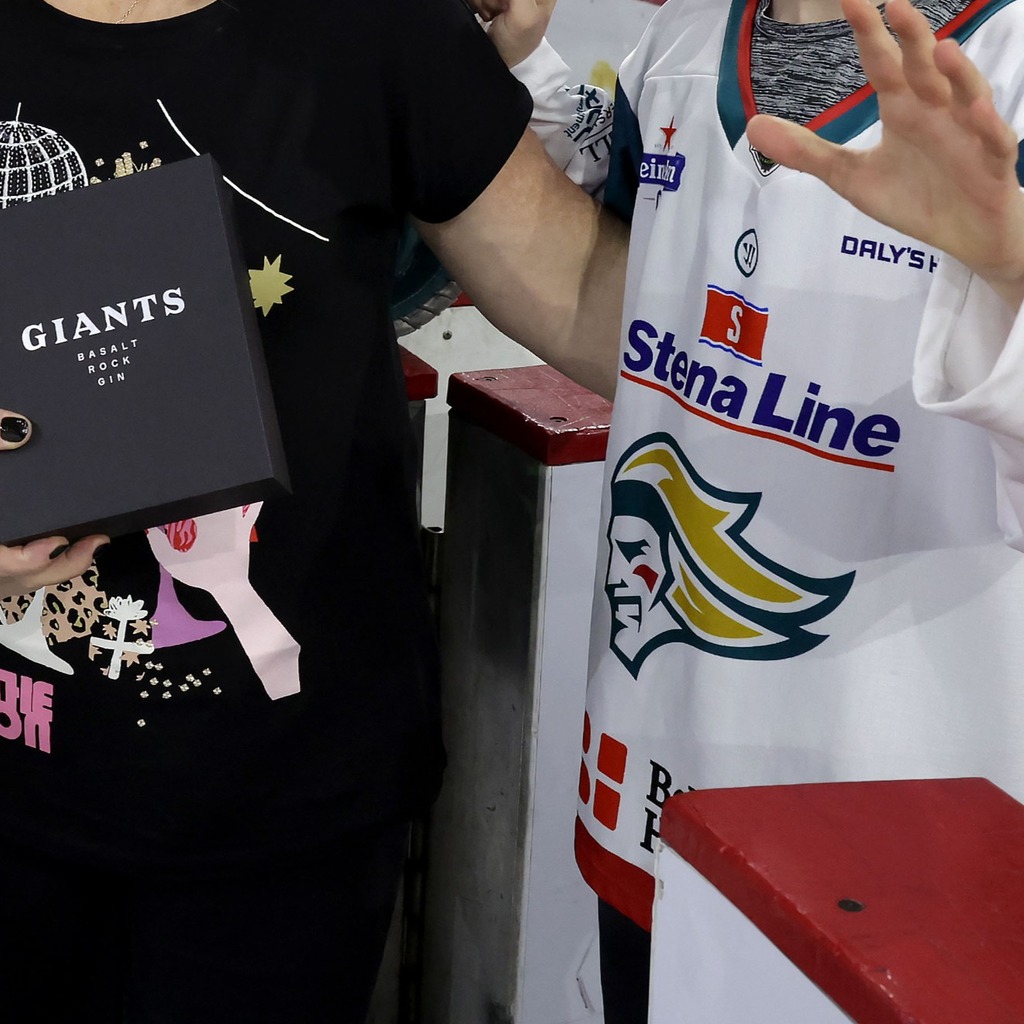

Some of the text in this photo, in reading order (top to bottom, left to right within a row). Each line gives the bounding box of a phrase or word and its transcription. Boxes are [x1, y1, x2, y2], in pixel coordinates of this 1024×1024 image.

[840, 235, 925, 269] DALY'S
[21, 287, 186, 351] GIANTS
[726, 304, 743, 343] S
[77, 338, 138, 362] BASALT
[88, 356, 131, 374] ROCK
[97, 372, 126, 387] GIN
[623, 319, 901, 457] Stena Line
